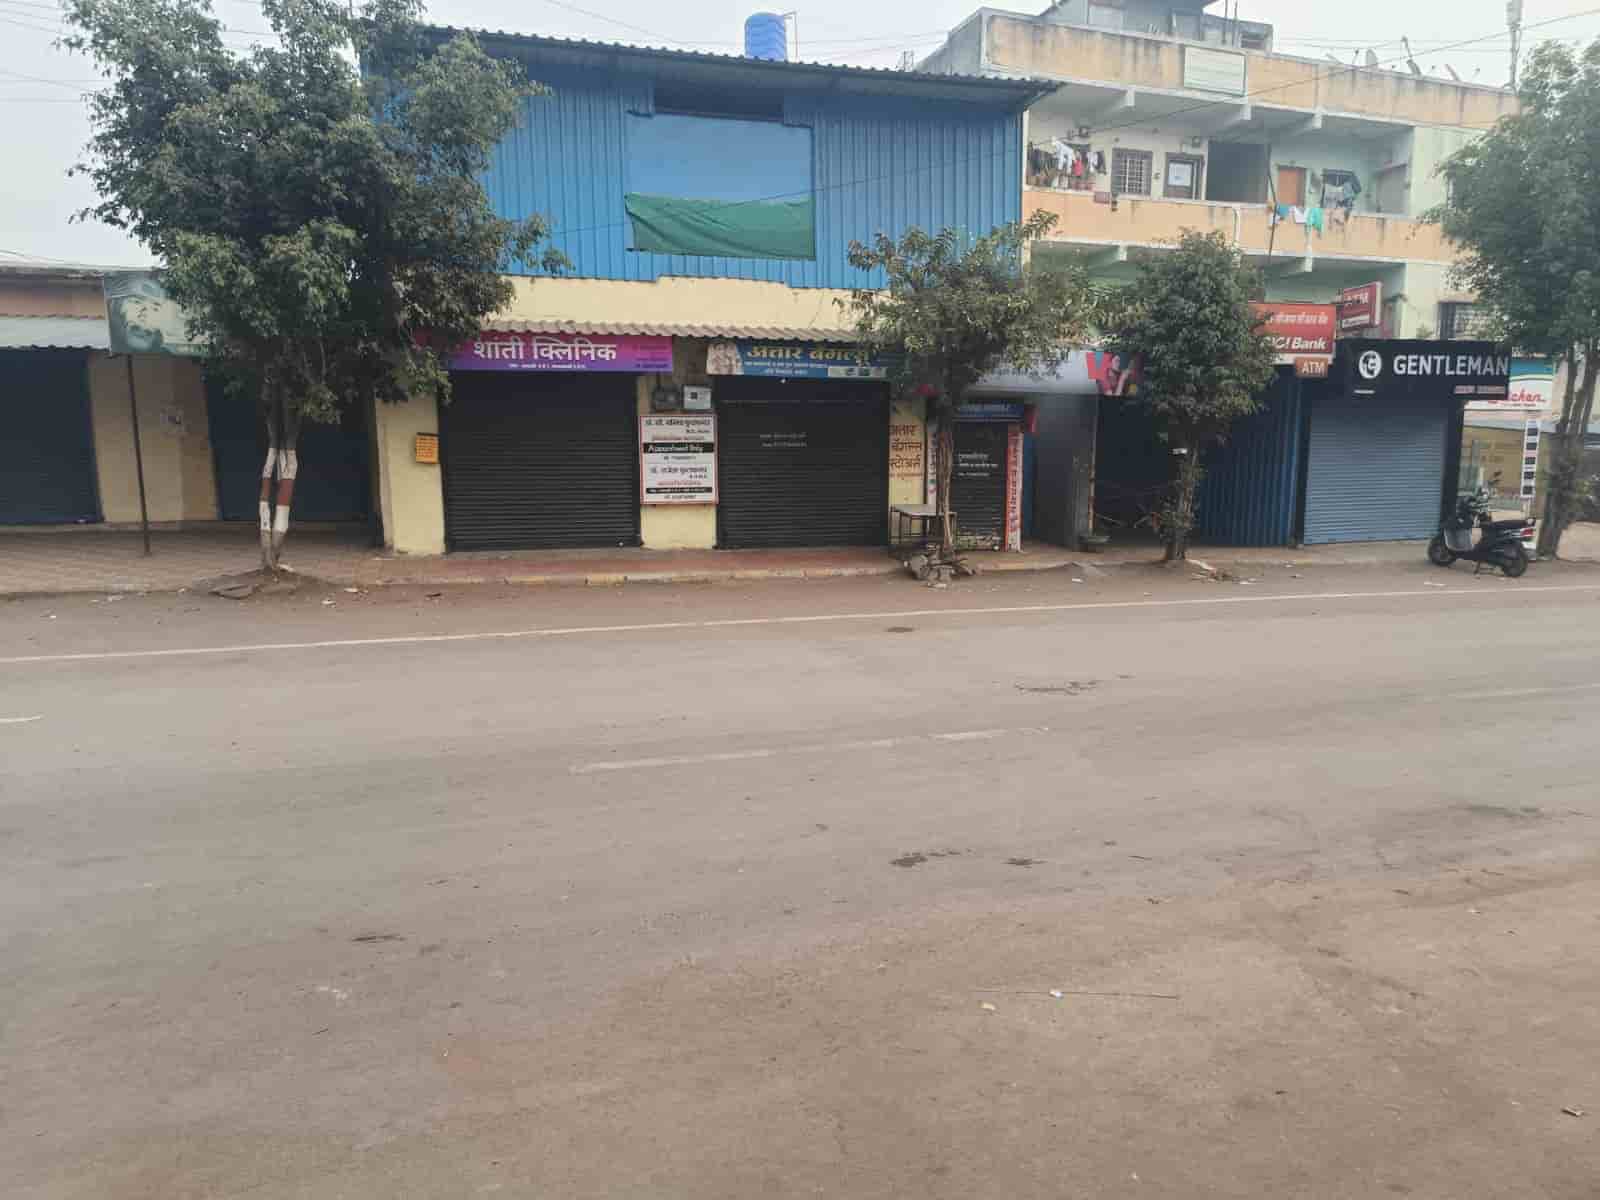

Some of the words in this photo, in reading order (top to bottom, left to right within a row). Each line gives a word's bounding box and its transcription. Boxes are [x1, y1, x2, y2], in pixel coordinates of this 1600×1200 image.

[473, 336, 525, 359] शांती
[533, 336, 617, 361] क्लिनिक
[1291, 337, 1327, 350] Bank
[1301, 360, 1326, 375] ATM
[1393, 355, 1509, 376] GENTLEMAN
